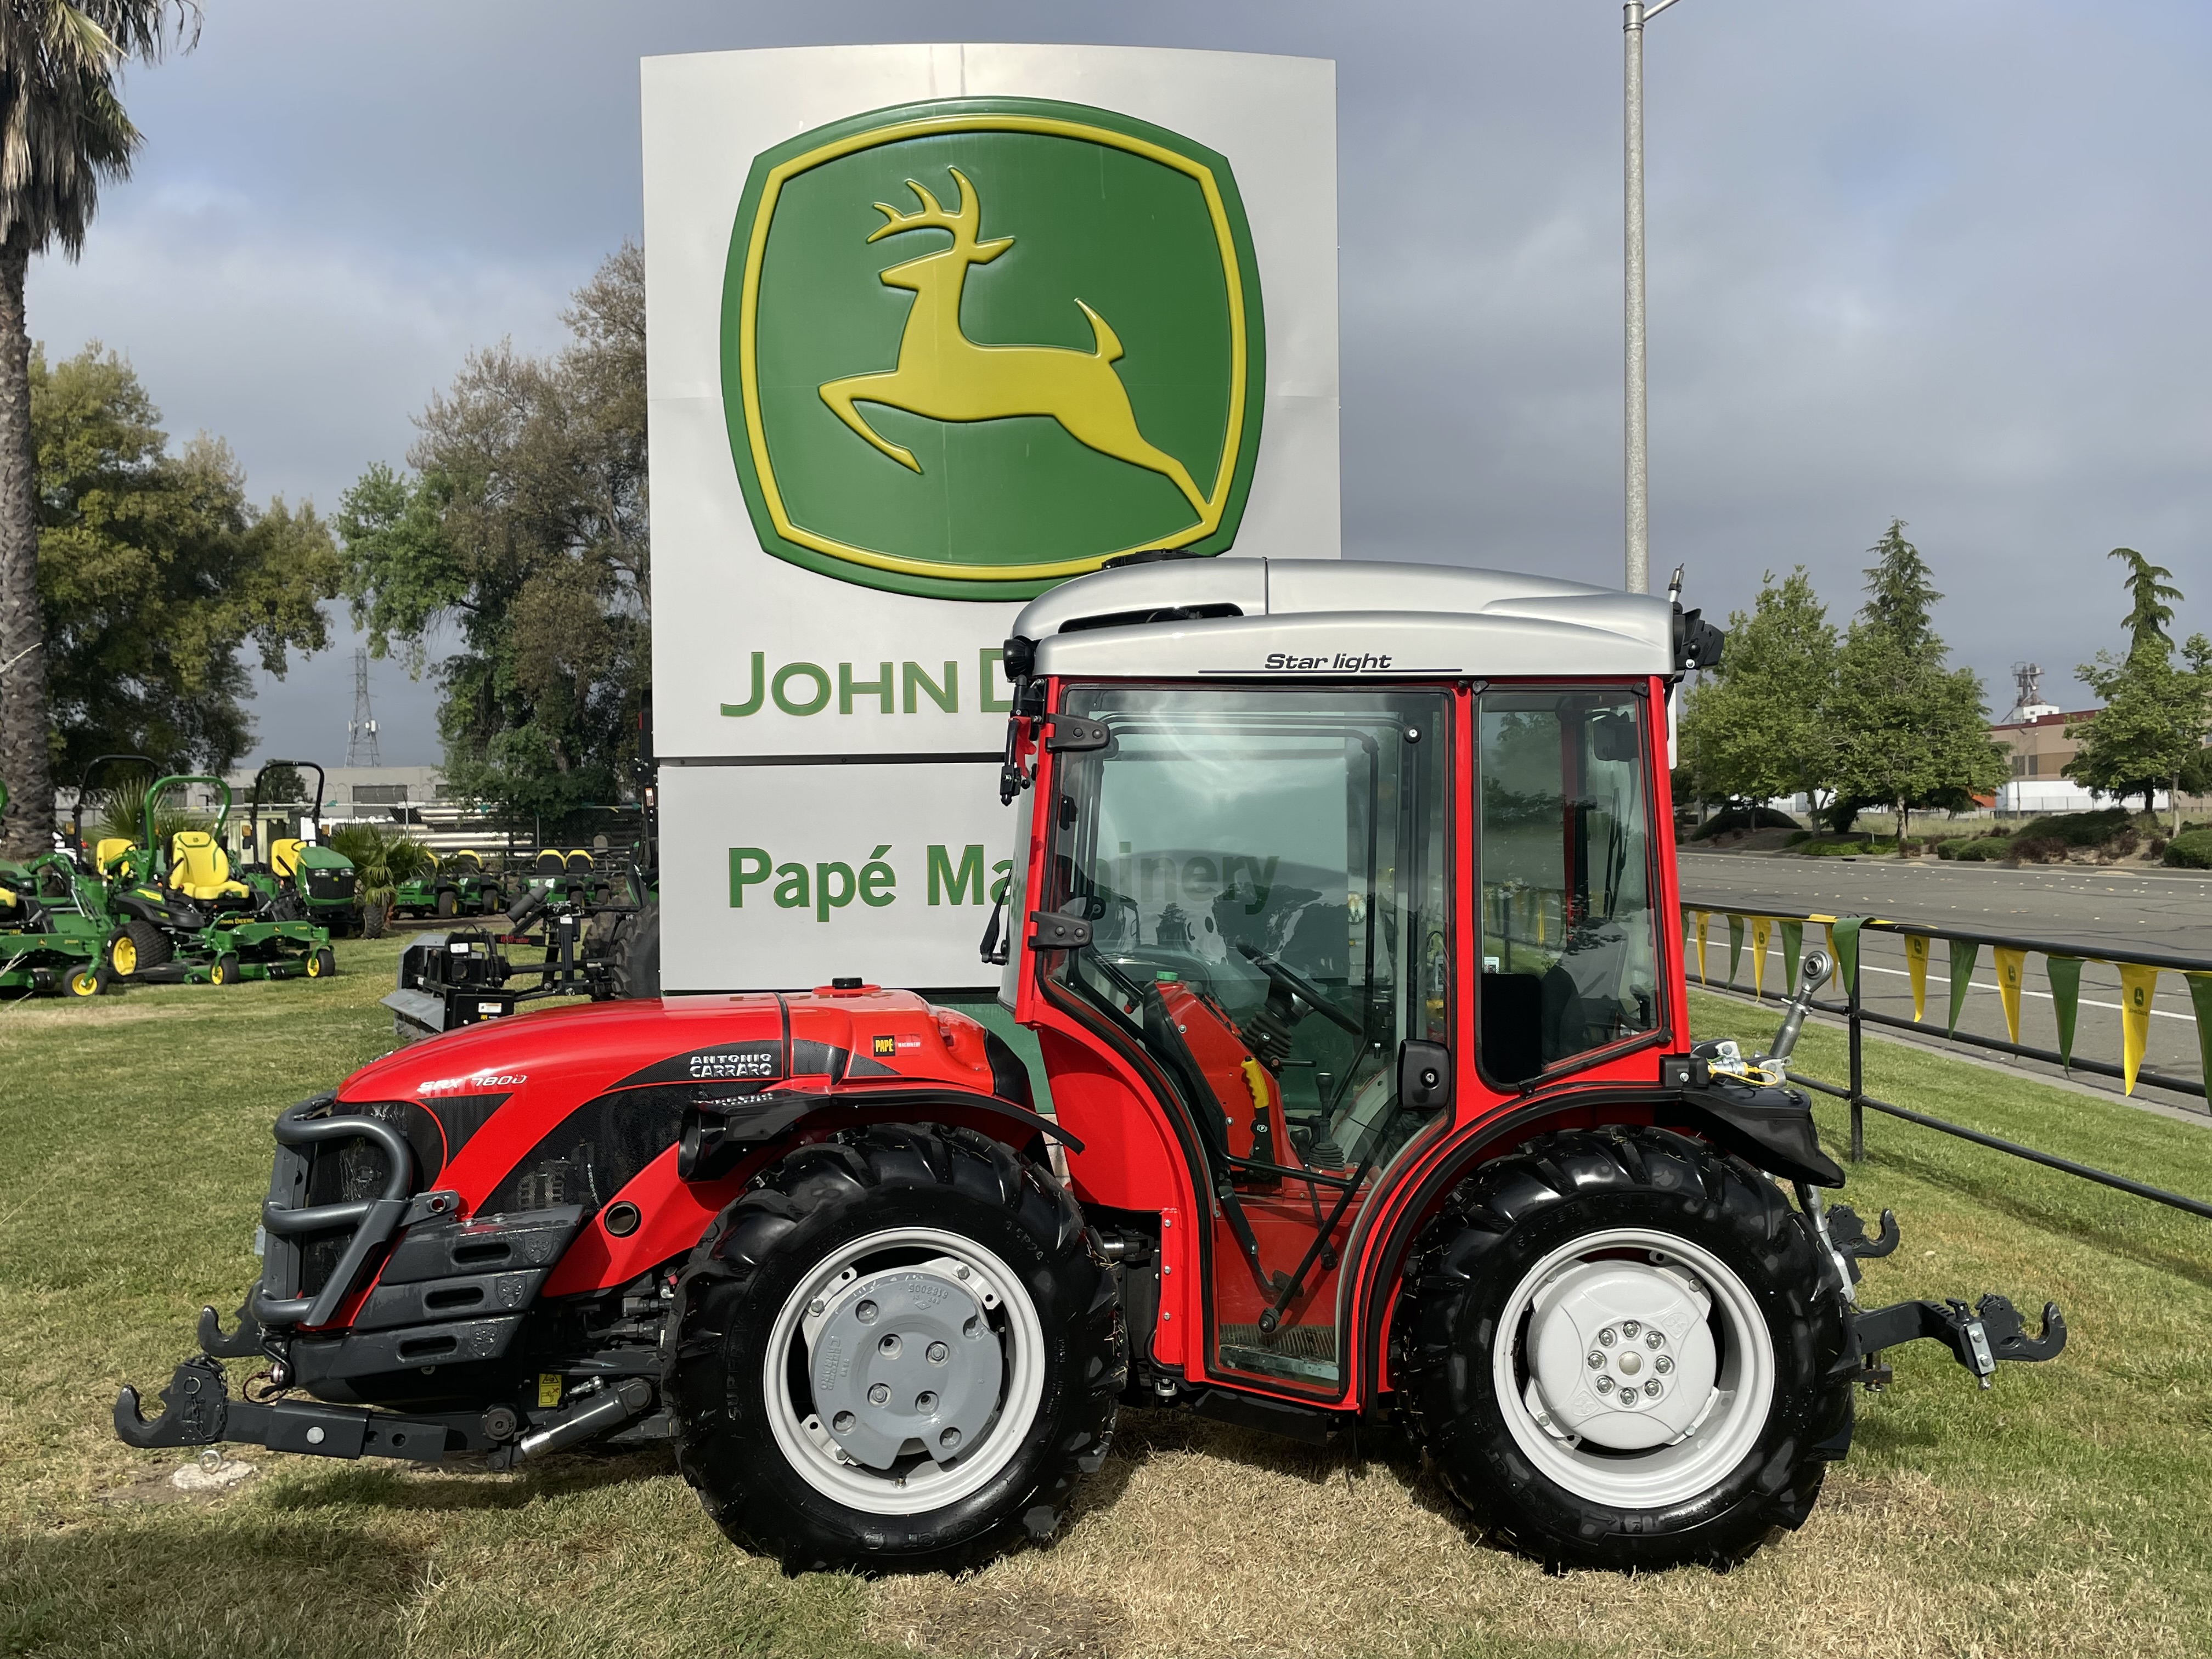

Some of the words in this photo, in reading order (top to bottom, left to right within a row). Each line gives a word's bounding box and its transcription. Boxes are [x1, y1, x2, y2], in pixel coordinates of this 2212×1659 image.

[1265, 653, 1328, 669] Star
[1332, 653, 1392, 673] light
[720, 651, 958, 716] JOHN
[729, 844, 896, 923] Papé
[927, 842, 1280, 915] Mainery
[690, 1053, 772, 1065] ANTONIO
[689, 1063, 772, 1078] CARRARO
[416, 1079, 463, 1092] SRX
